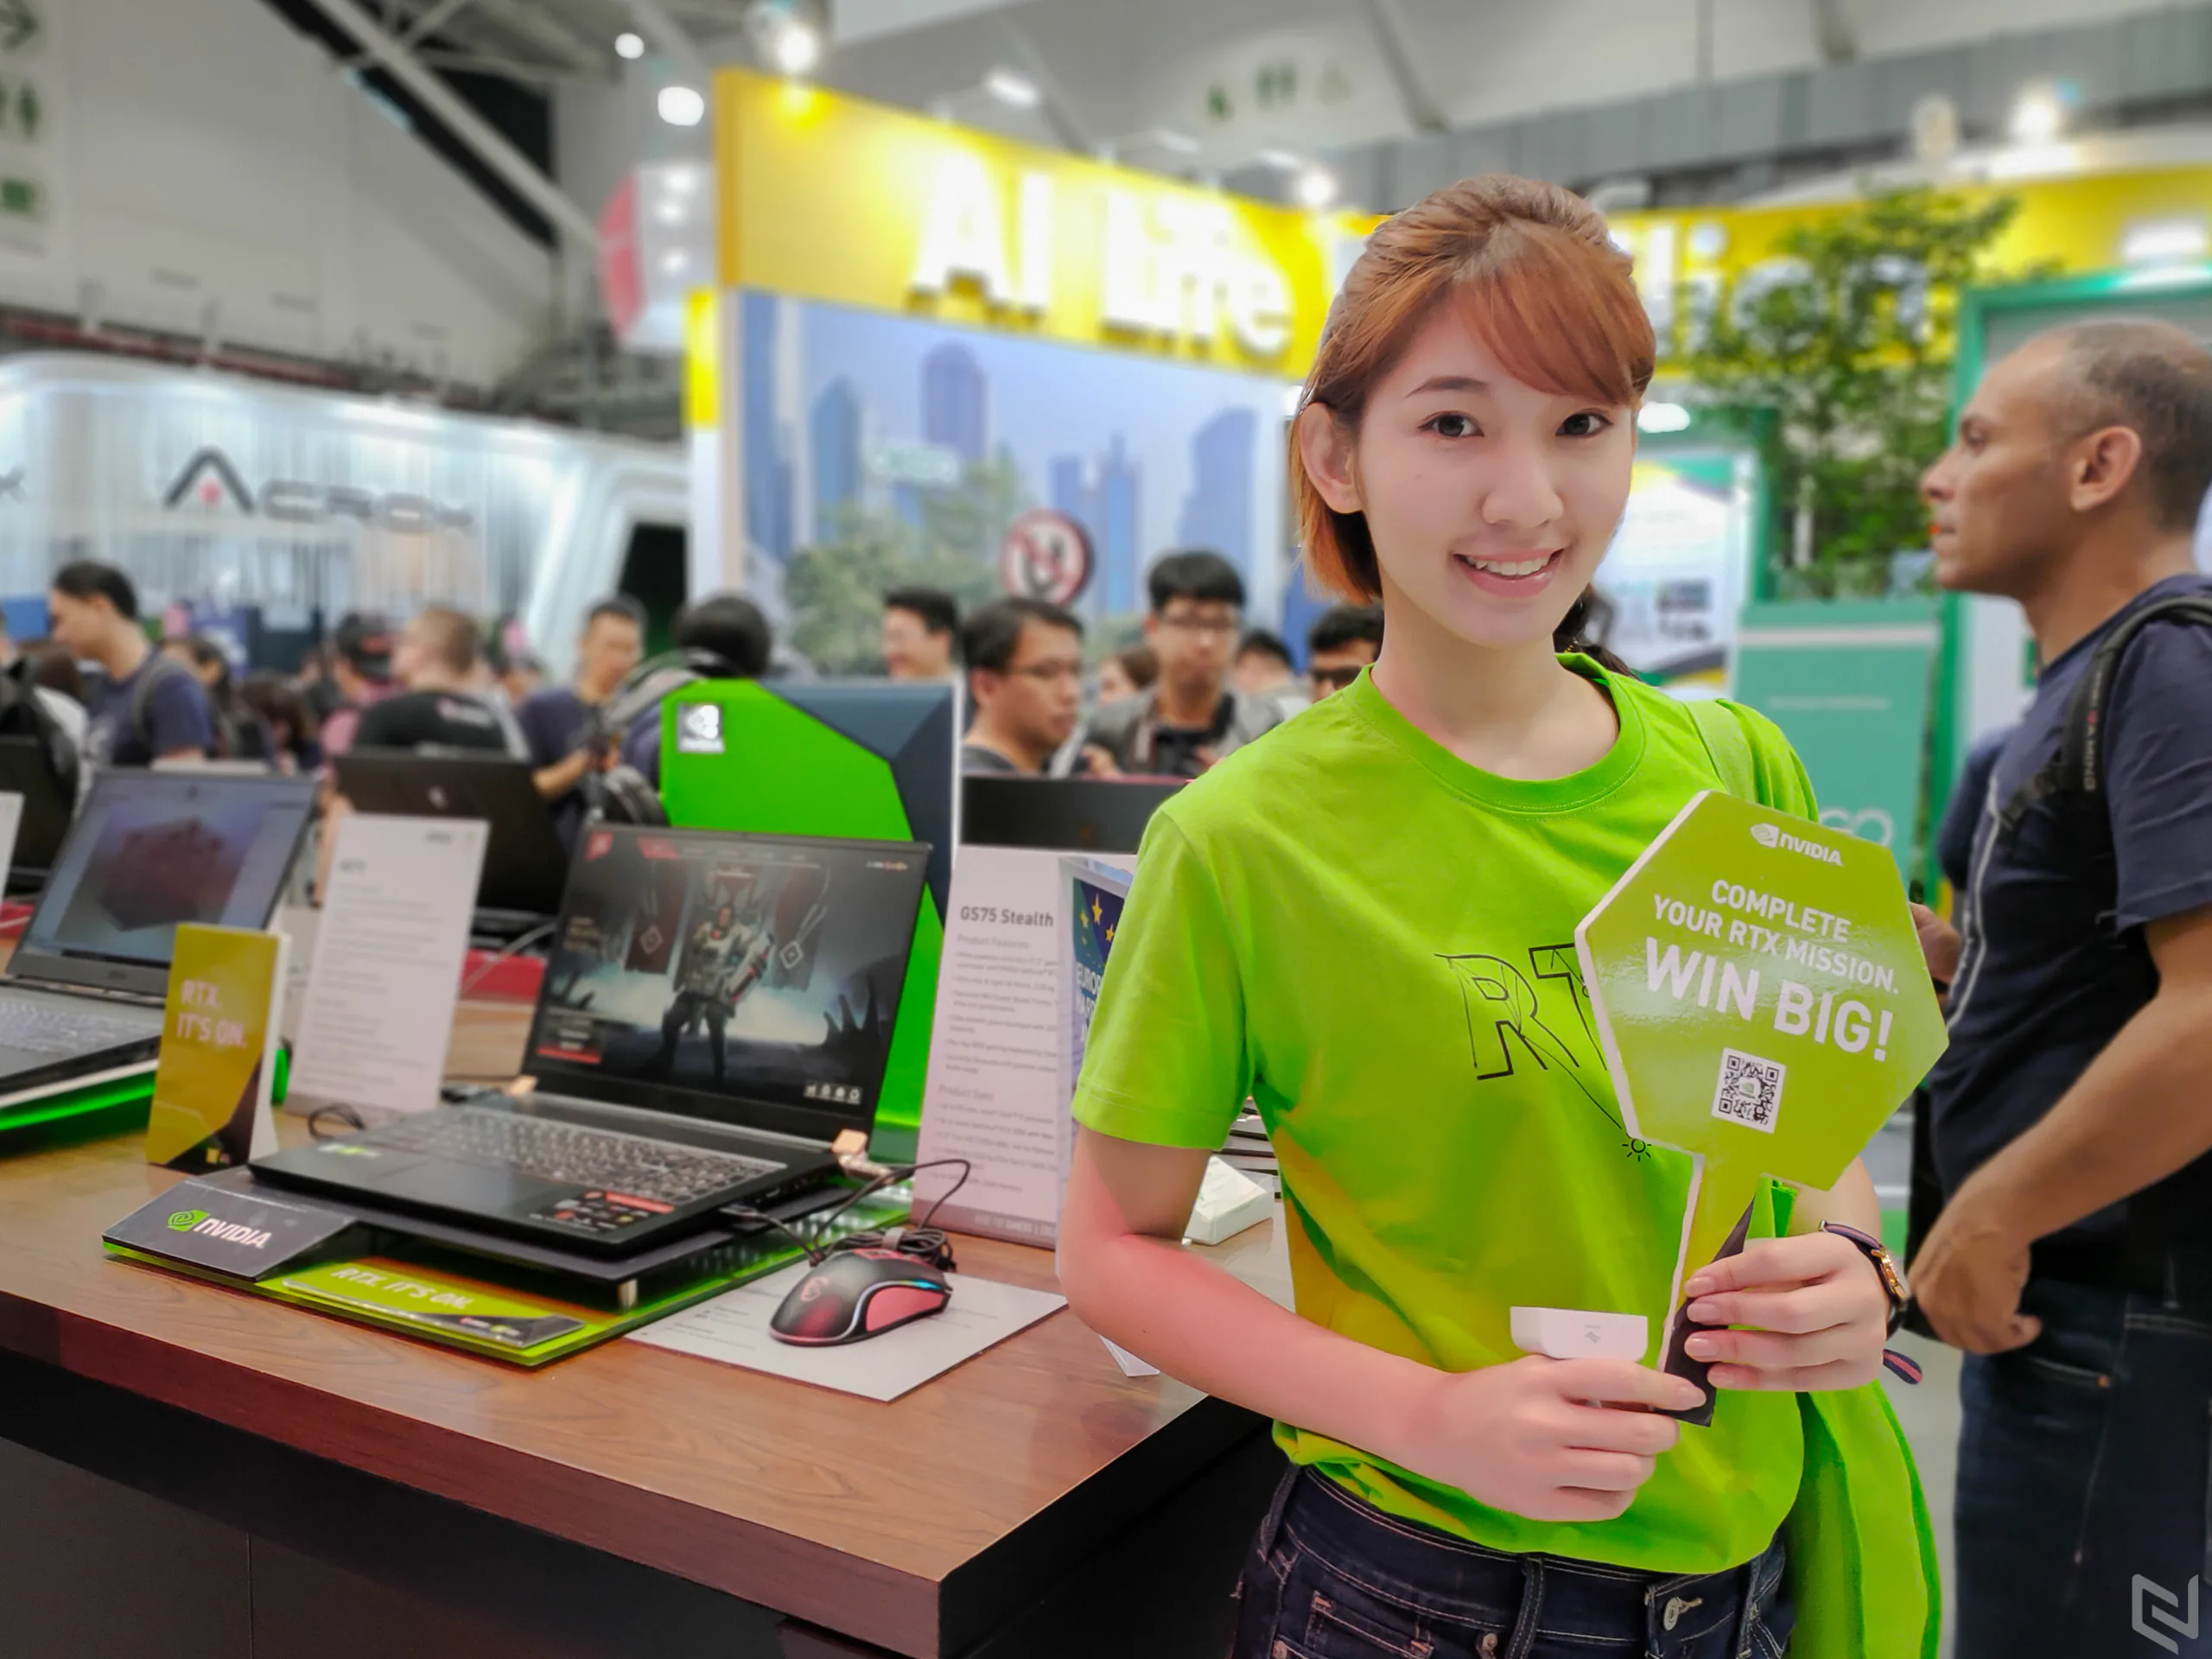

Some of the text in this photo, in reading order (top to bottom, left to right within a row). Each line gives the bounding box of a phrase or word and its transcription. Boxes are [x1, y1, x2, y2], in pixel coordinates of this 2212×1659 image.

[1779, 831, 1844, 867] NVIDIA
[960, 906, 1054, 928] GS75 Stealth
[1712, 879, 1851, 944] COMPLETE
[1653, 894, 1899, 995] YOUR RTX MISSION.
[1646, 936, 1893, 1062] WIN BIG!
[193, 1217, 273, 1249] NVIDIA
